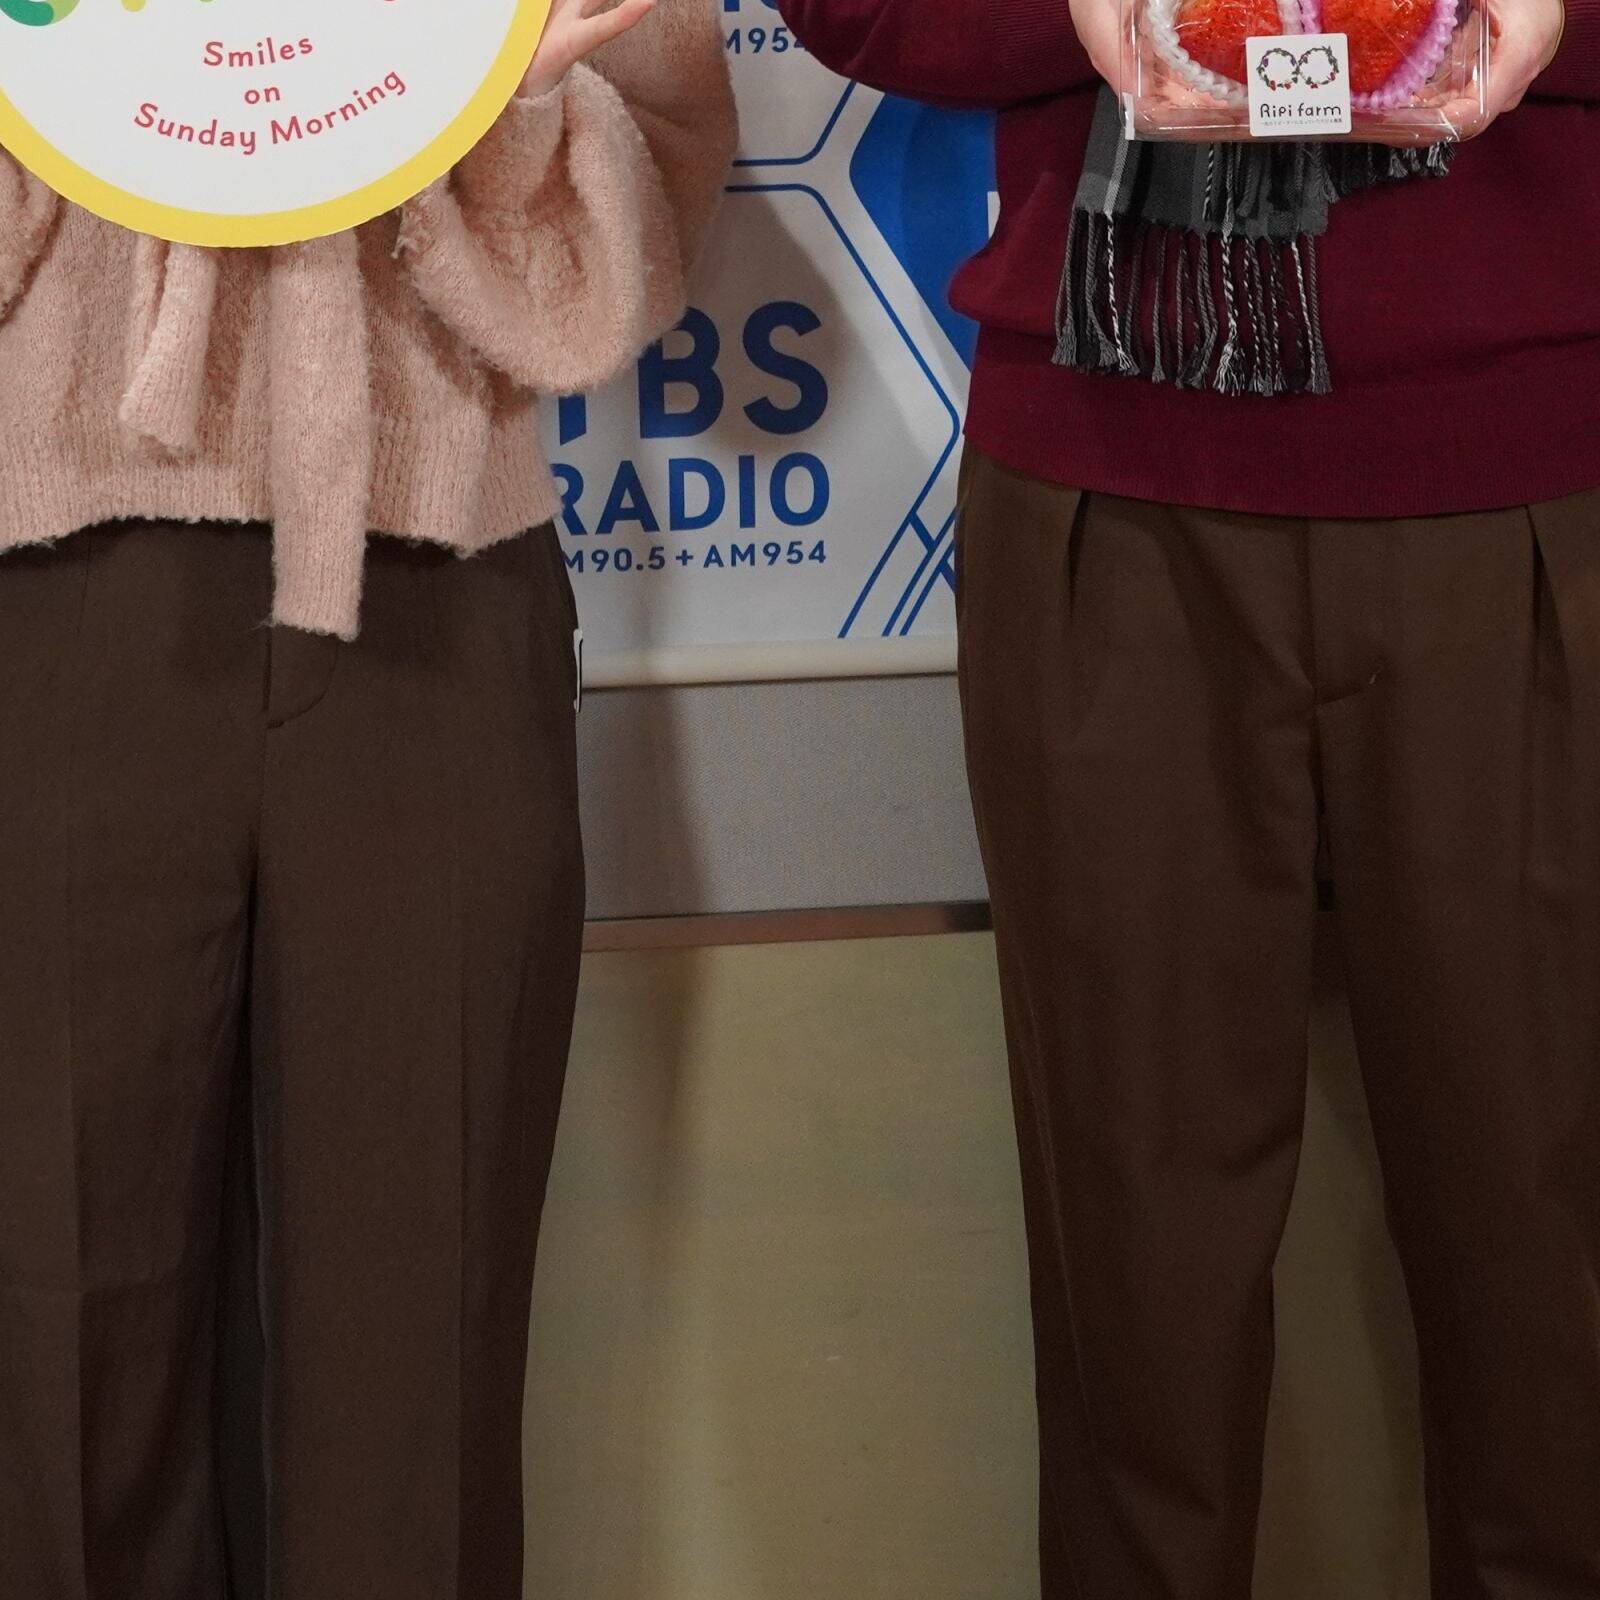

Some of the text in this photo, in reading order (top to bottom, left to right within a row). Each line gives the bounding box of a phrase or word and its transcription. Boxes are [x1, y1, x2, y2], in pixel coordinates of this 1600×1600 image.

[203, 37, 314, 68] Smiles
[244, 84, 281, 106] on
[1297, 102, 1342, 117] farm
[133, 70, 407, 156] Sunday Morning
[552, 452, 830, 536] RADIO
[564, 540, 827, 574] M90.5+AM954
